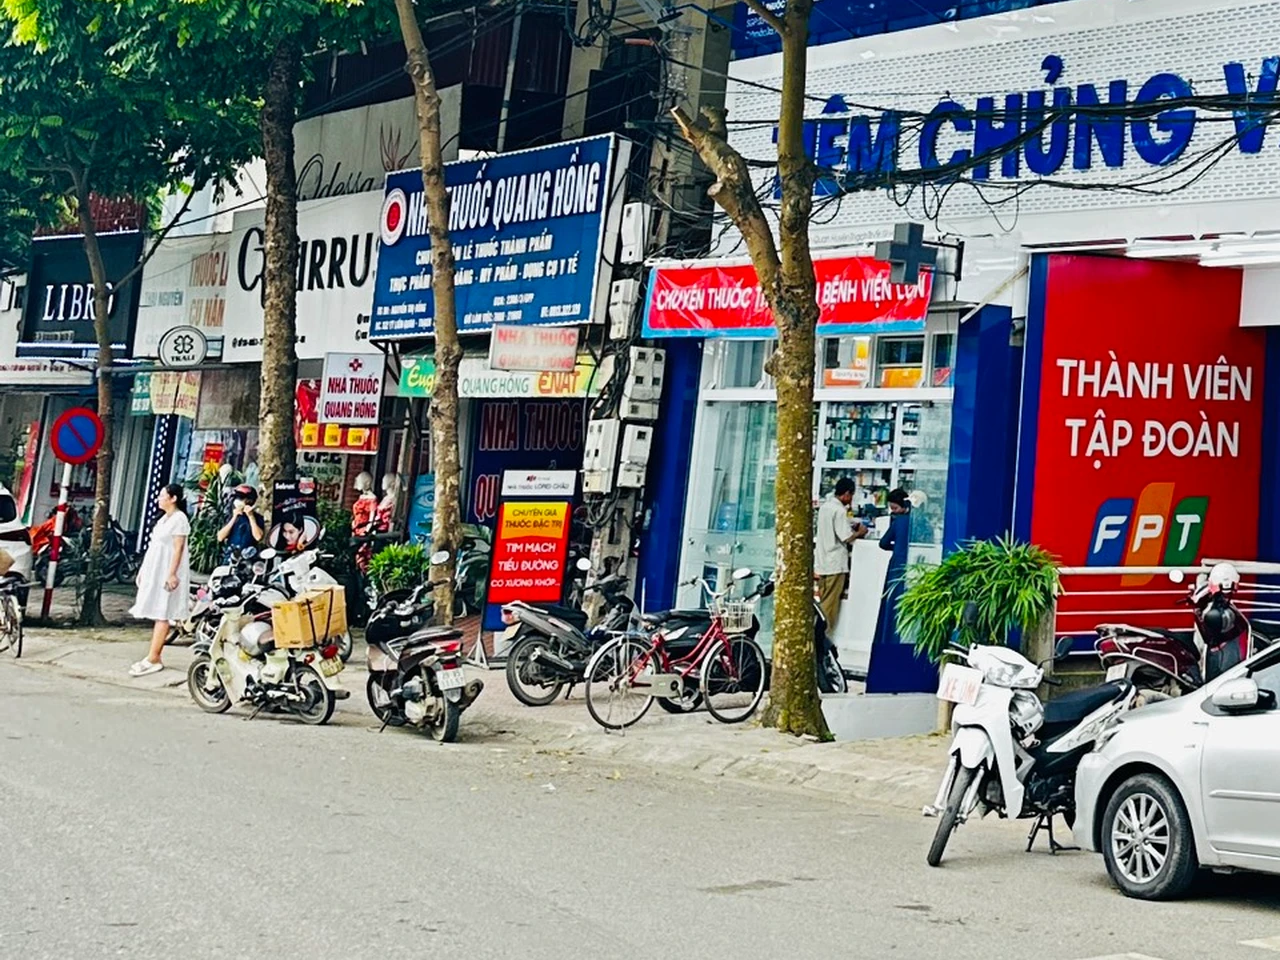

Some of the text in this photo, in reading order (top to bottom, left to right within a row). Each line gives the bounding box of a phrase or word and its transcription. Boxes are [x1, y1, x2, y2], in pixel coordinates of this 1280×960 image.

[918, 53, 1197, 178] CHỦNG
[492, 173, 551, 230] QUANG
[550, 147, 600, 218] HỒNG
[708, 277, 751, 310] THUỐC
[823, 279, 855, 312] BỆNH
[861, 274, 891, 309] VIỆN
[327, 372, 380, 395] NHÀ THUỐC
[1056, 350, 1253, 401] THÀNH VIÊN
[324, 396, 377, 419] QUANG HỒNG
[1065, 408, 1240, 470] TẬP ĐOÀN
[506, 542, 556, 556] TIM MẠCH
[1093, 513, 1201, 554] FPT
